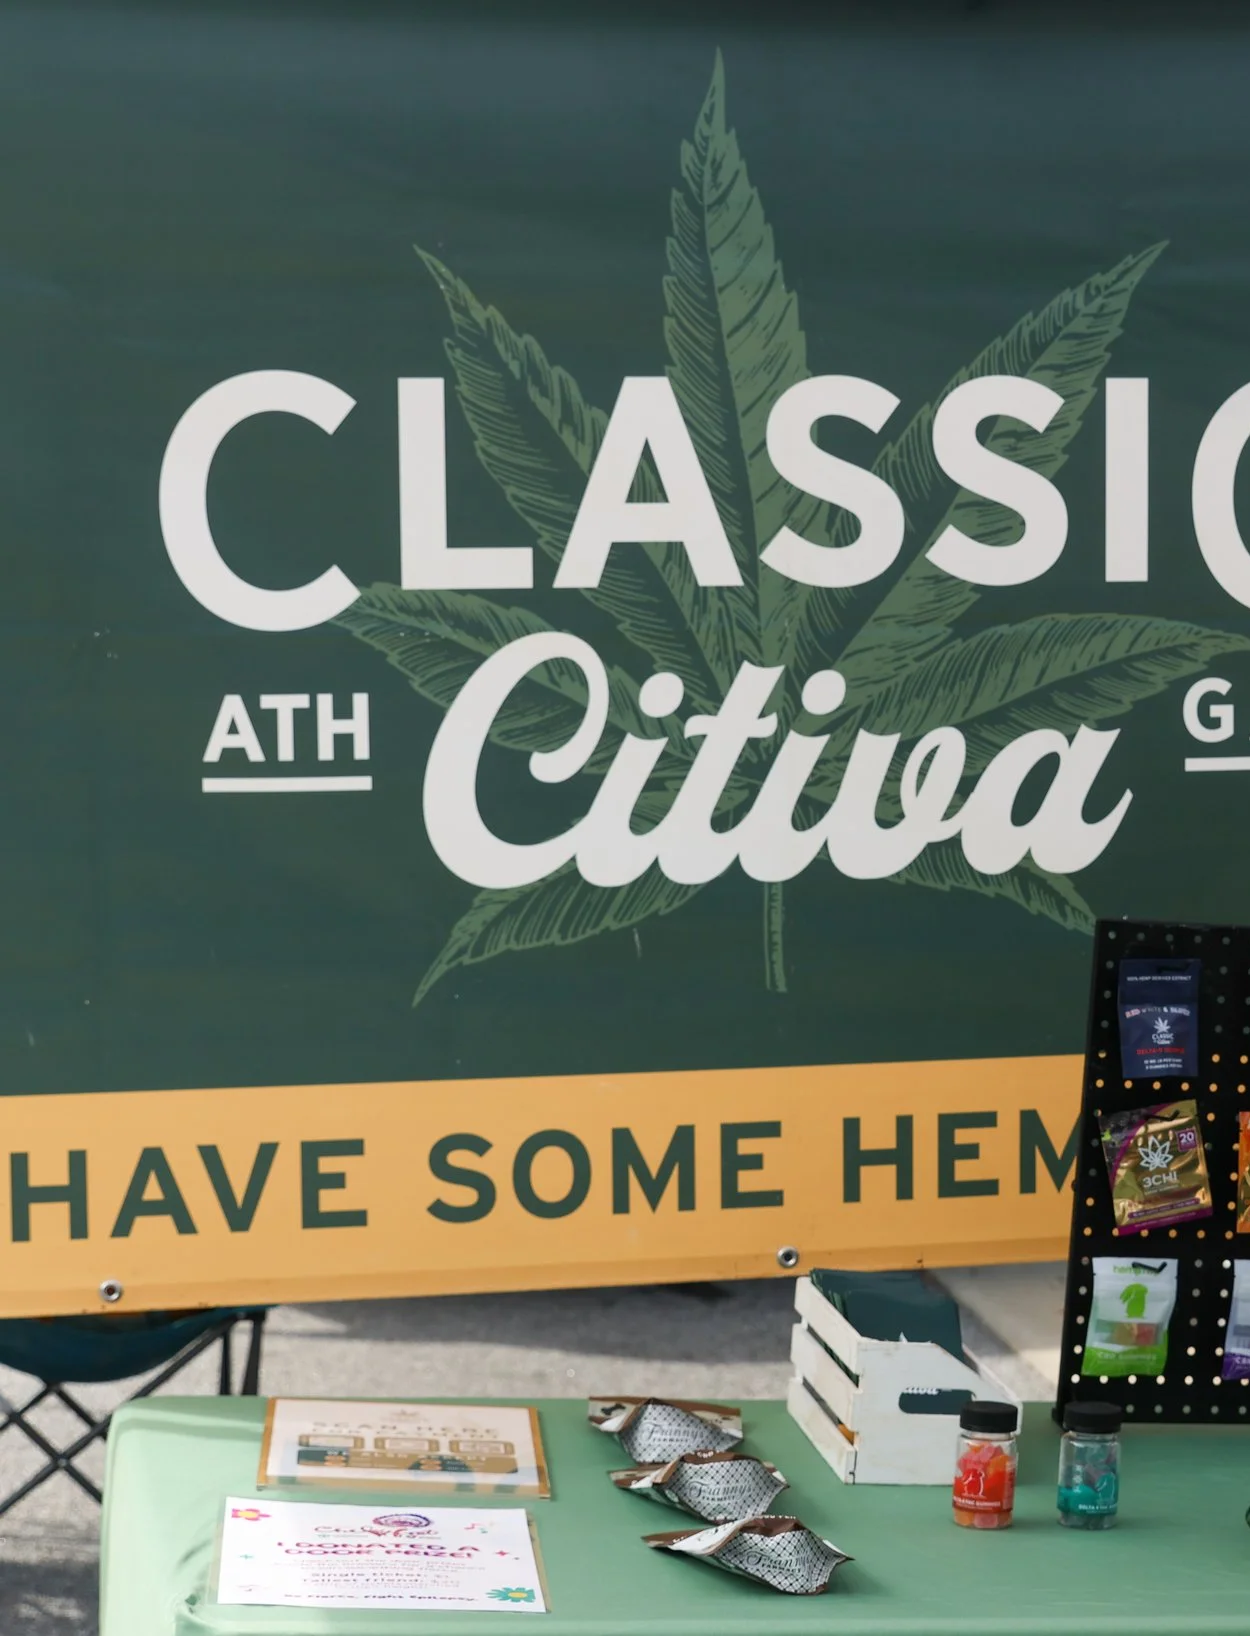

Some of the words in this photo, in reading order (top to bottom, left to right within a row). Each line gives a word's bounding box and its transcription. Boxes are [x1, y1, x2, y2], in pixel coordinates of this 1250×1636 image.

[202, 692, 370, 762] ATH
[423, 631, 1133, 889] Citiva
[1179, 1131, 1195, 1144] 20
[8, 1138, 369, 1243] HAVE
[426, 1120, 785, 1224] SOME
[1143, 1171, 1178, 1188] 3CHI
